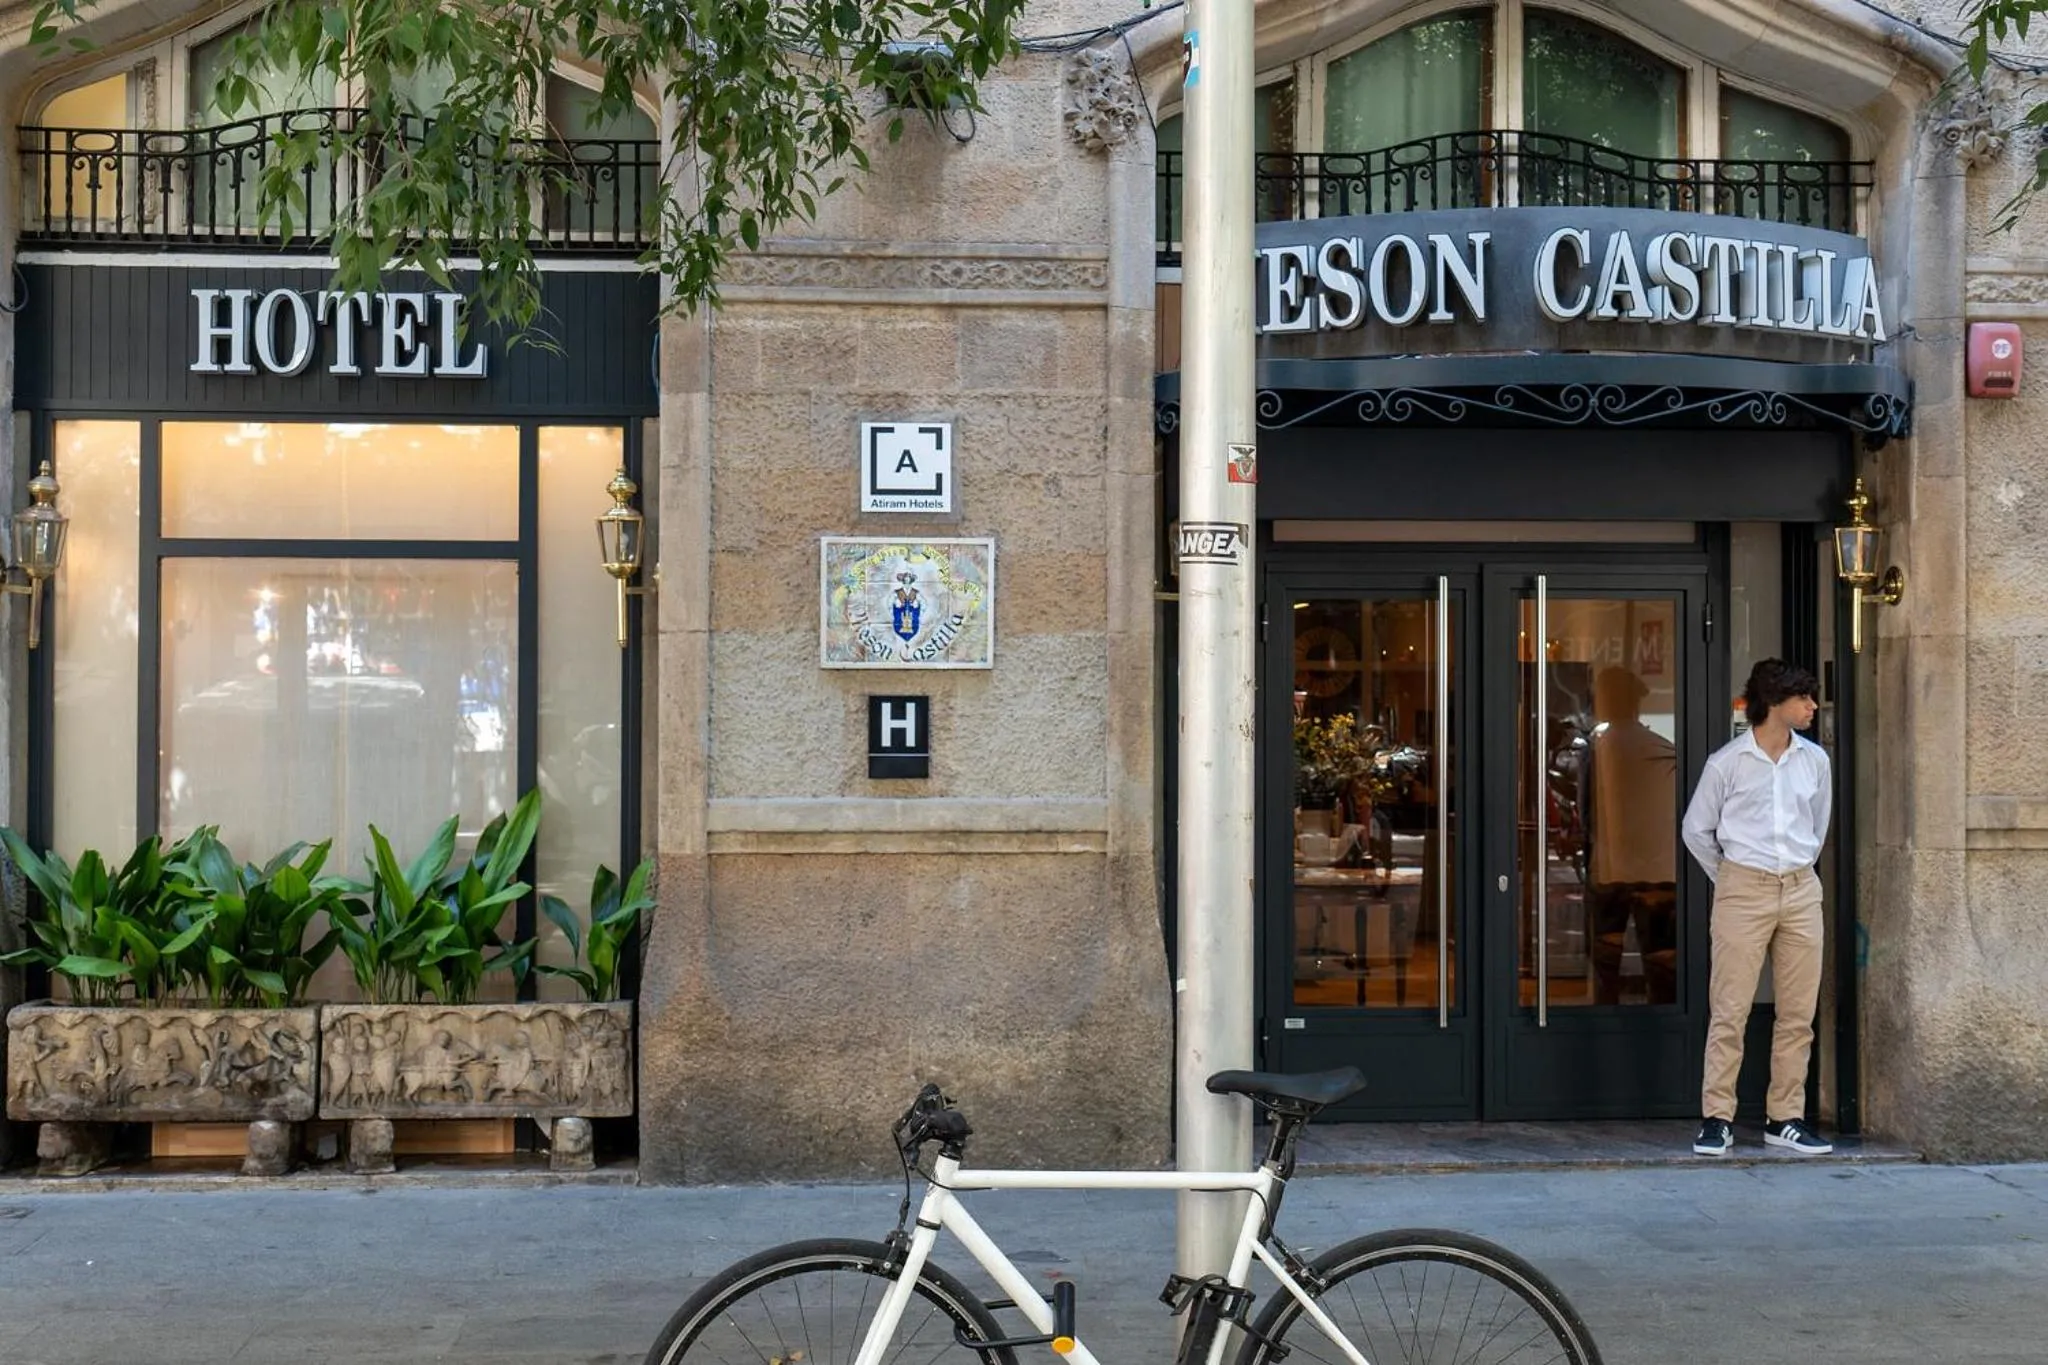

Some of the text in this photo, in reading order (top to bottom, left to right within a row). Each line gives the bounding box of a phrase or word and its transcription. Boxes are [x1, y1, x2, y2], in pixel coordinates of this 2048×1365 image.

[1256, 227, 1887, 342] ESON CASTILLA
[190, 287, 488, 379] HOTEL
[895, 449, 918, 473] A
[870, 498, 944, 509] Atiram Hotels
[881, 702, 916, 748] H
